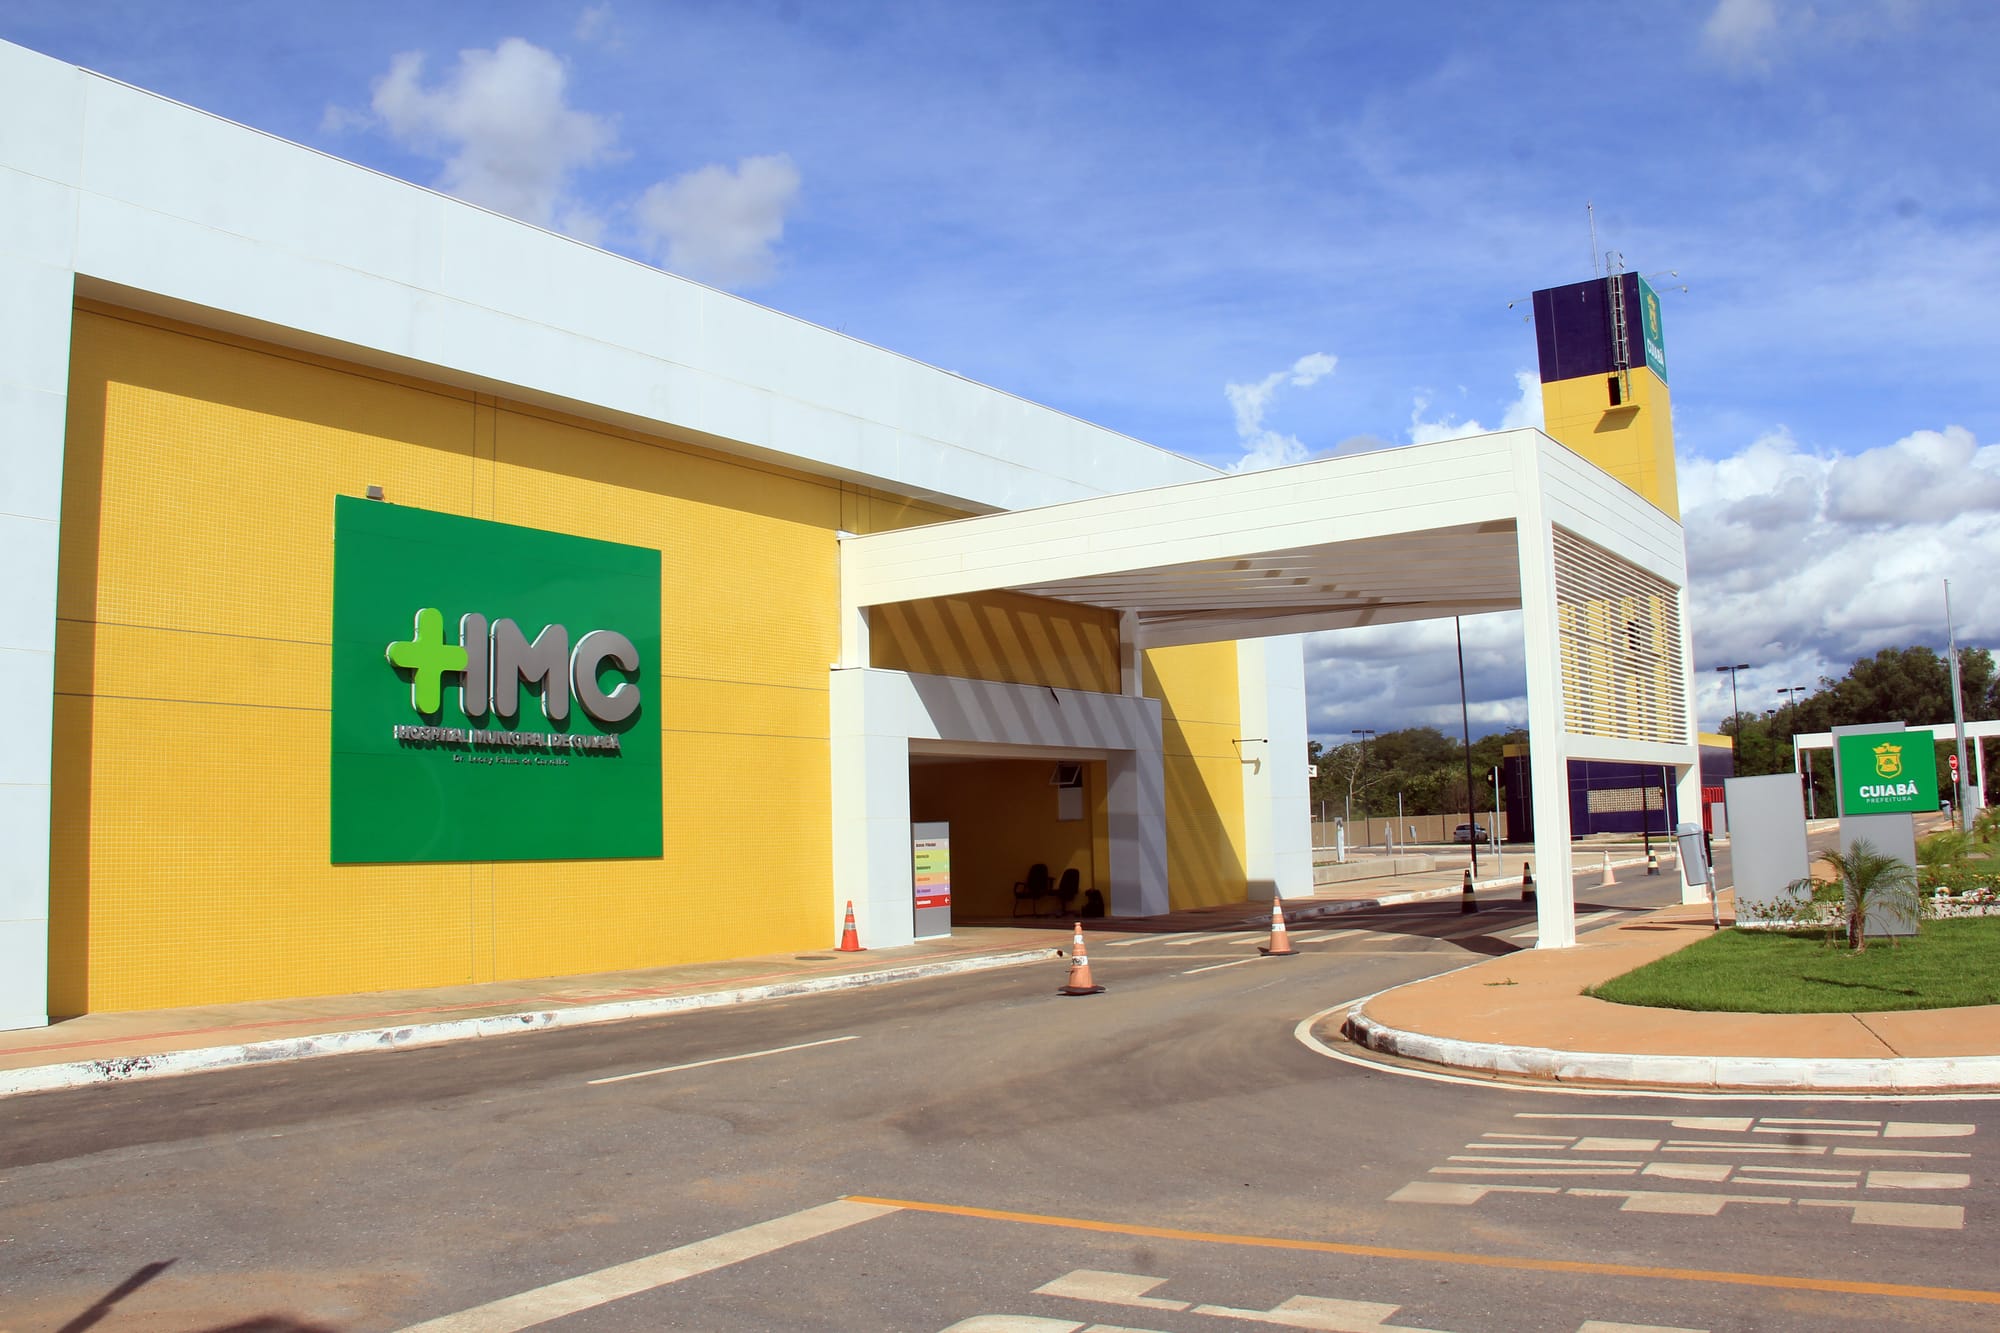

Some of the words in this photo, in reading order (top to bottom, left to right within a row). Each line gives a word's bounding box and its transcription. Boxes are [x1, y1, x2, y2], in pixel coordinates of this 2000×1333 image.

[394, 725, 470, 743] HOSPITAL
[469, 730, 548, 747] MUNICIPAL
[548, 733, 571, 747] DE
[1859, 780, 1919, 798] CUIABÁ
